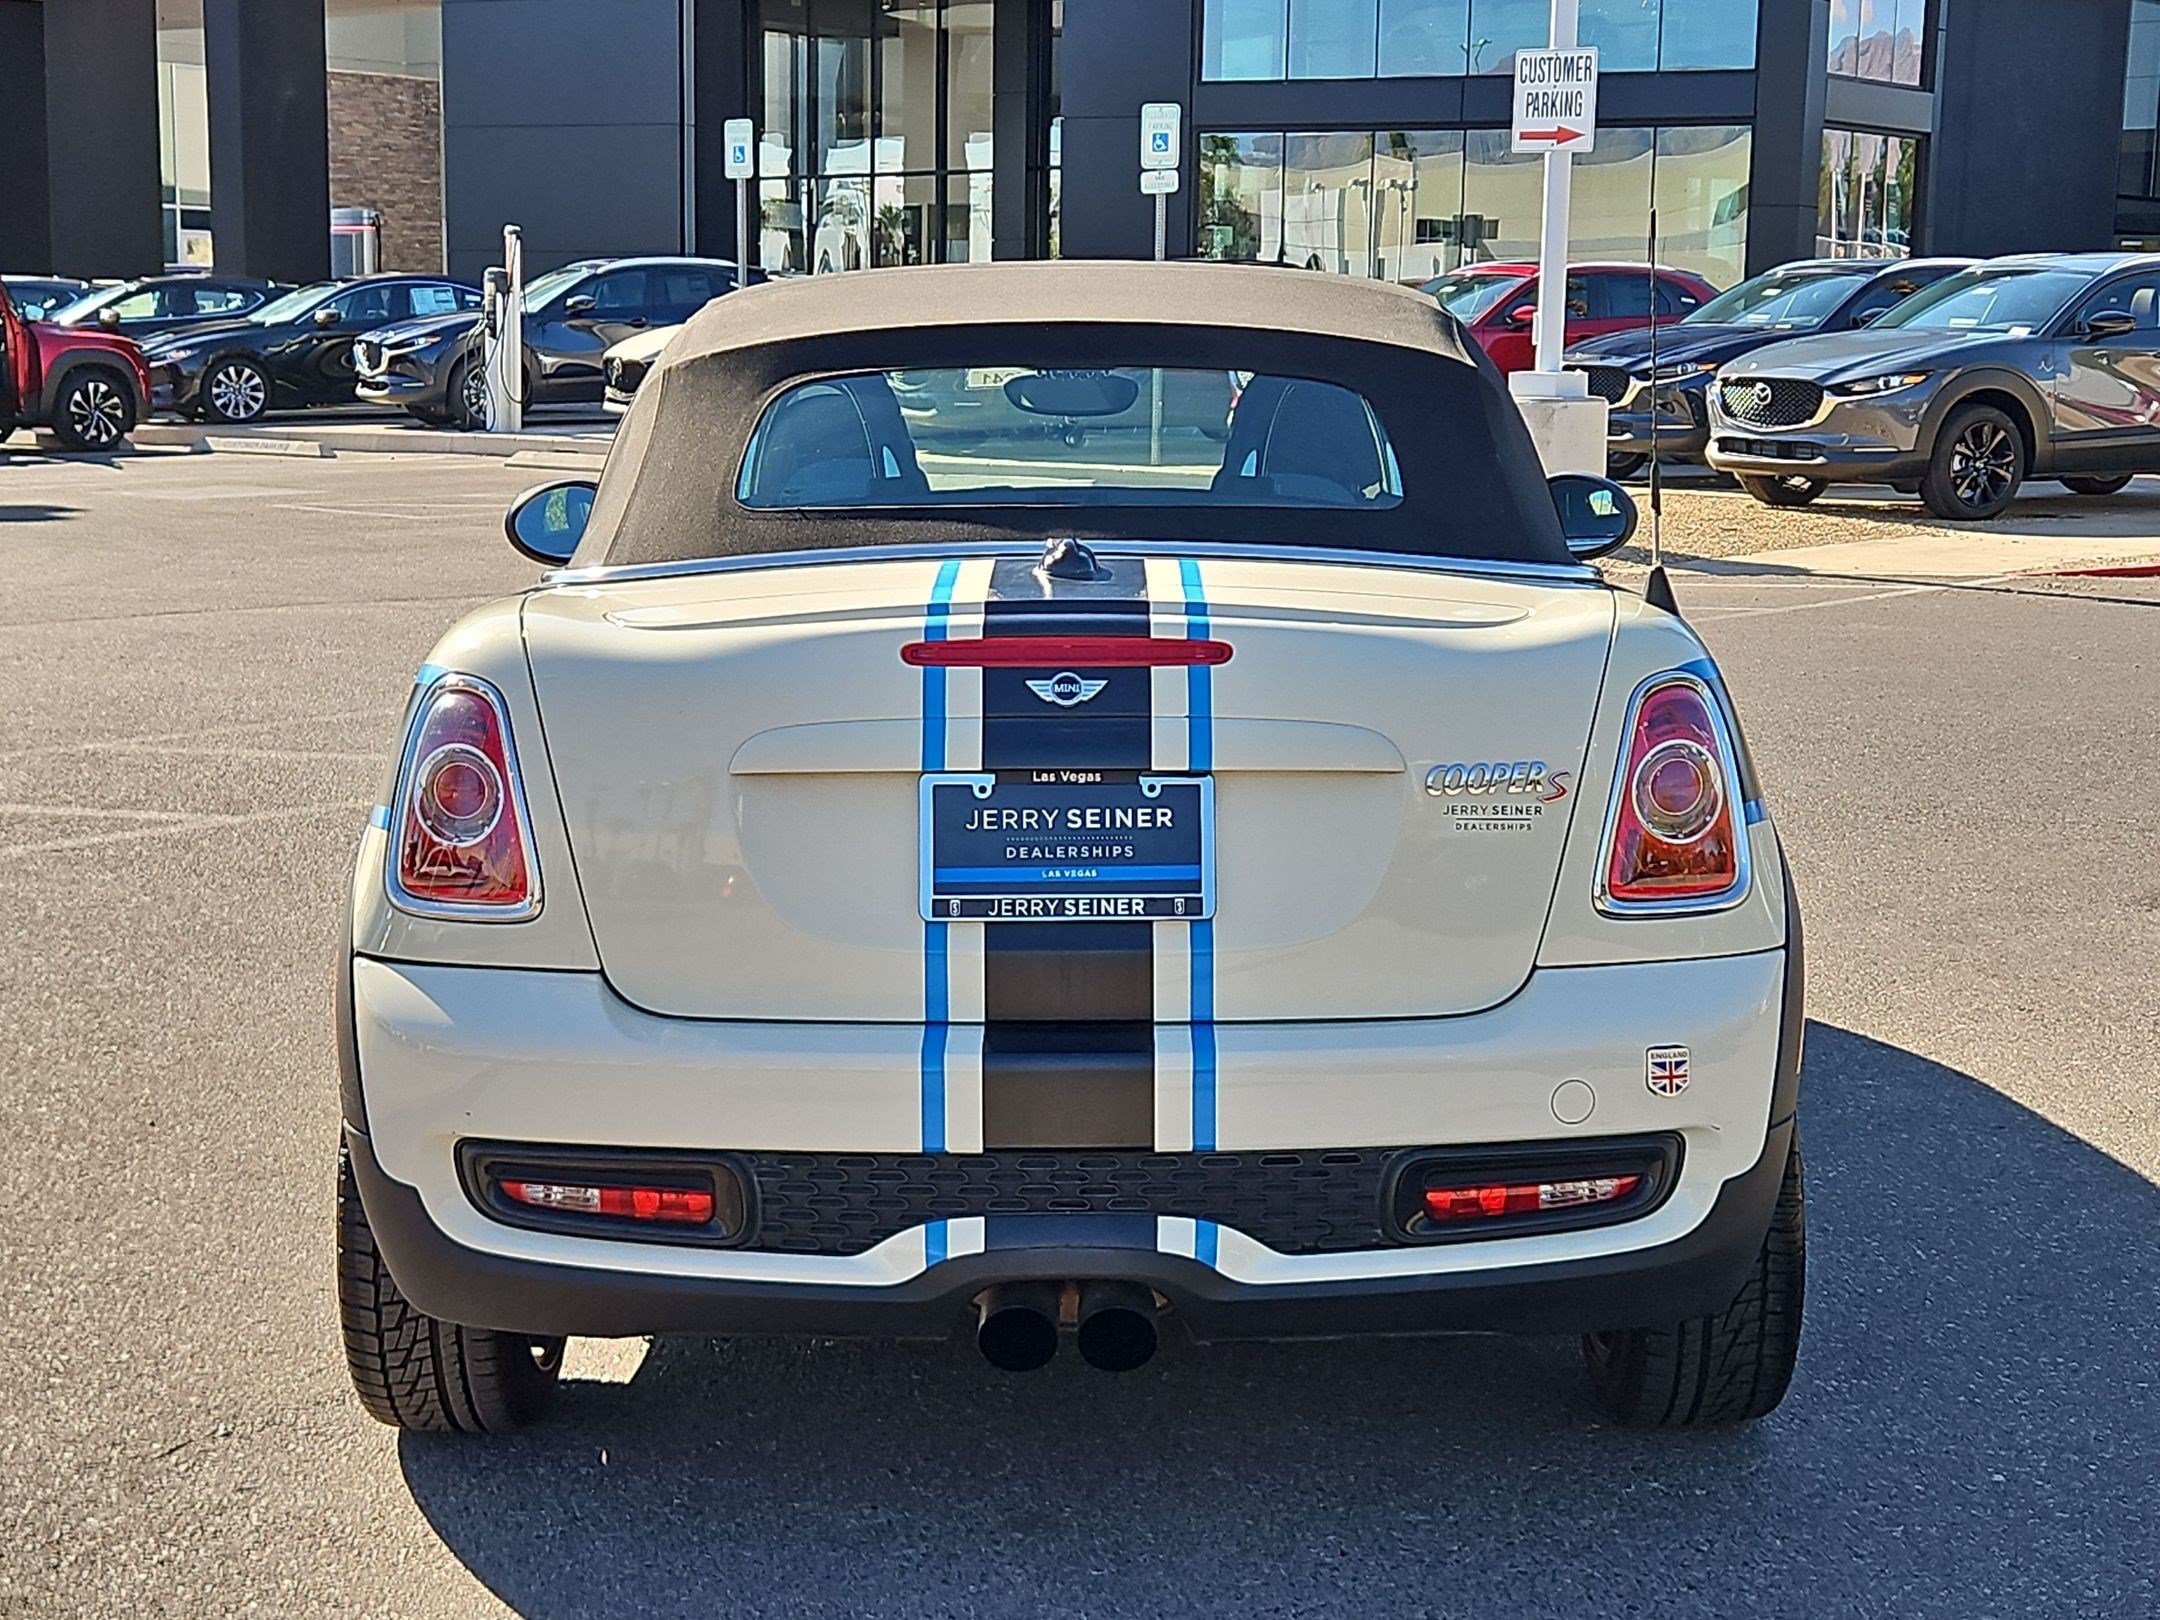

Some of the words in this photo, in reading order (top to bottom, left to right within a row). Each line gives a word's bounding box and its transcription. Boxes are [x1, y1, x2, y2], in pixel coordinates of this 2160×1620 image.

[1520, 55, 1593, 84] CUSTOMER
[1525, 91, 1583, 118] PARKING
[1054, 683, 1080, 693] MINI
[1033, 770, 1056, 782] Las
[1060, 770, 1102, 783] Vegas
[1425, 761, 1548, 797] COOPER
[1443, 805, 1488, 816] JERRY
[1492, 805, 1542, 816] SEINER
[965, 809, 1059, 830] JERRY
[1066, 808, 1174, 828] SEINER
[1456, 823, 1532, 831] DEALERSHIPS
[1006, 846, 1134, 858] DEALERSHIPS
[1042, 869, 1061, 878] LAS
[1064, 869, 1097, 878] VEGAS
[988, 899, 1057, 916] JERRY
[1064, 899, 1145, 915] SEINER
[1650, 1051, 1688, 1059] ENGLAND
